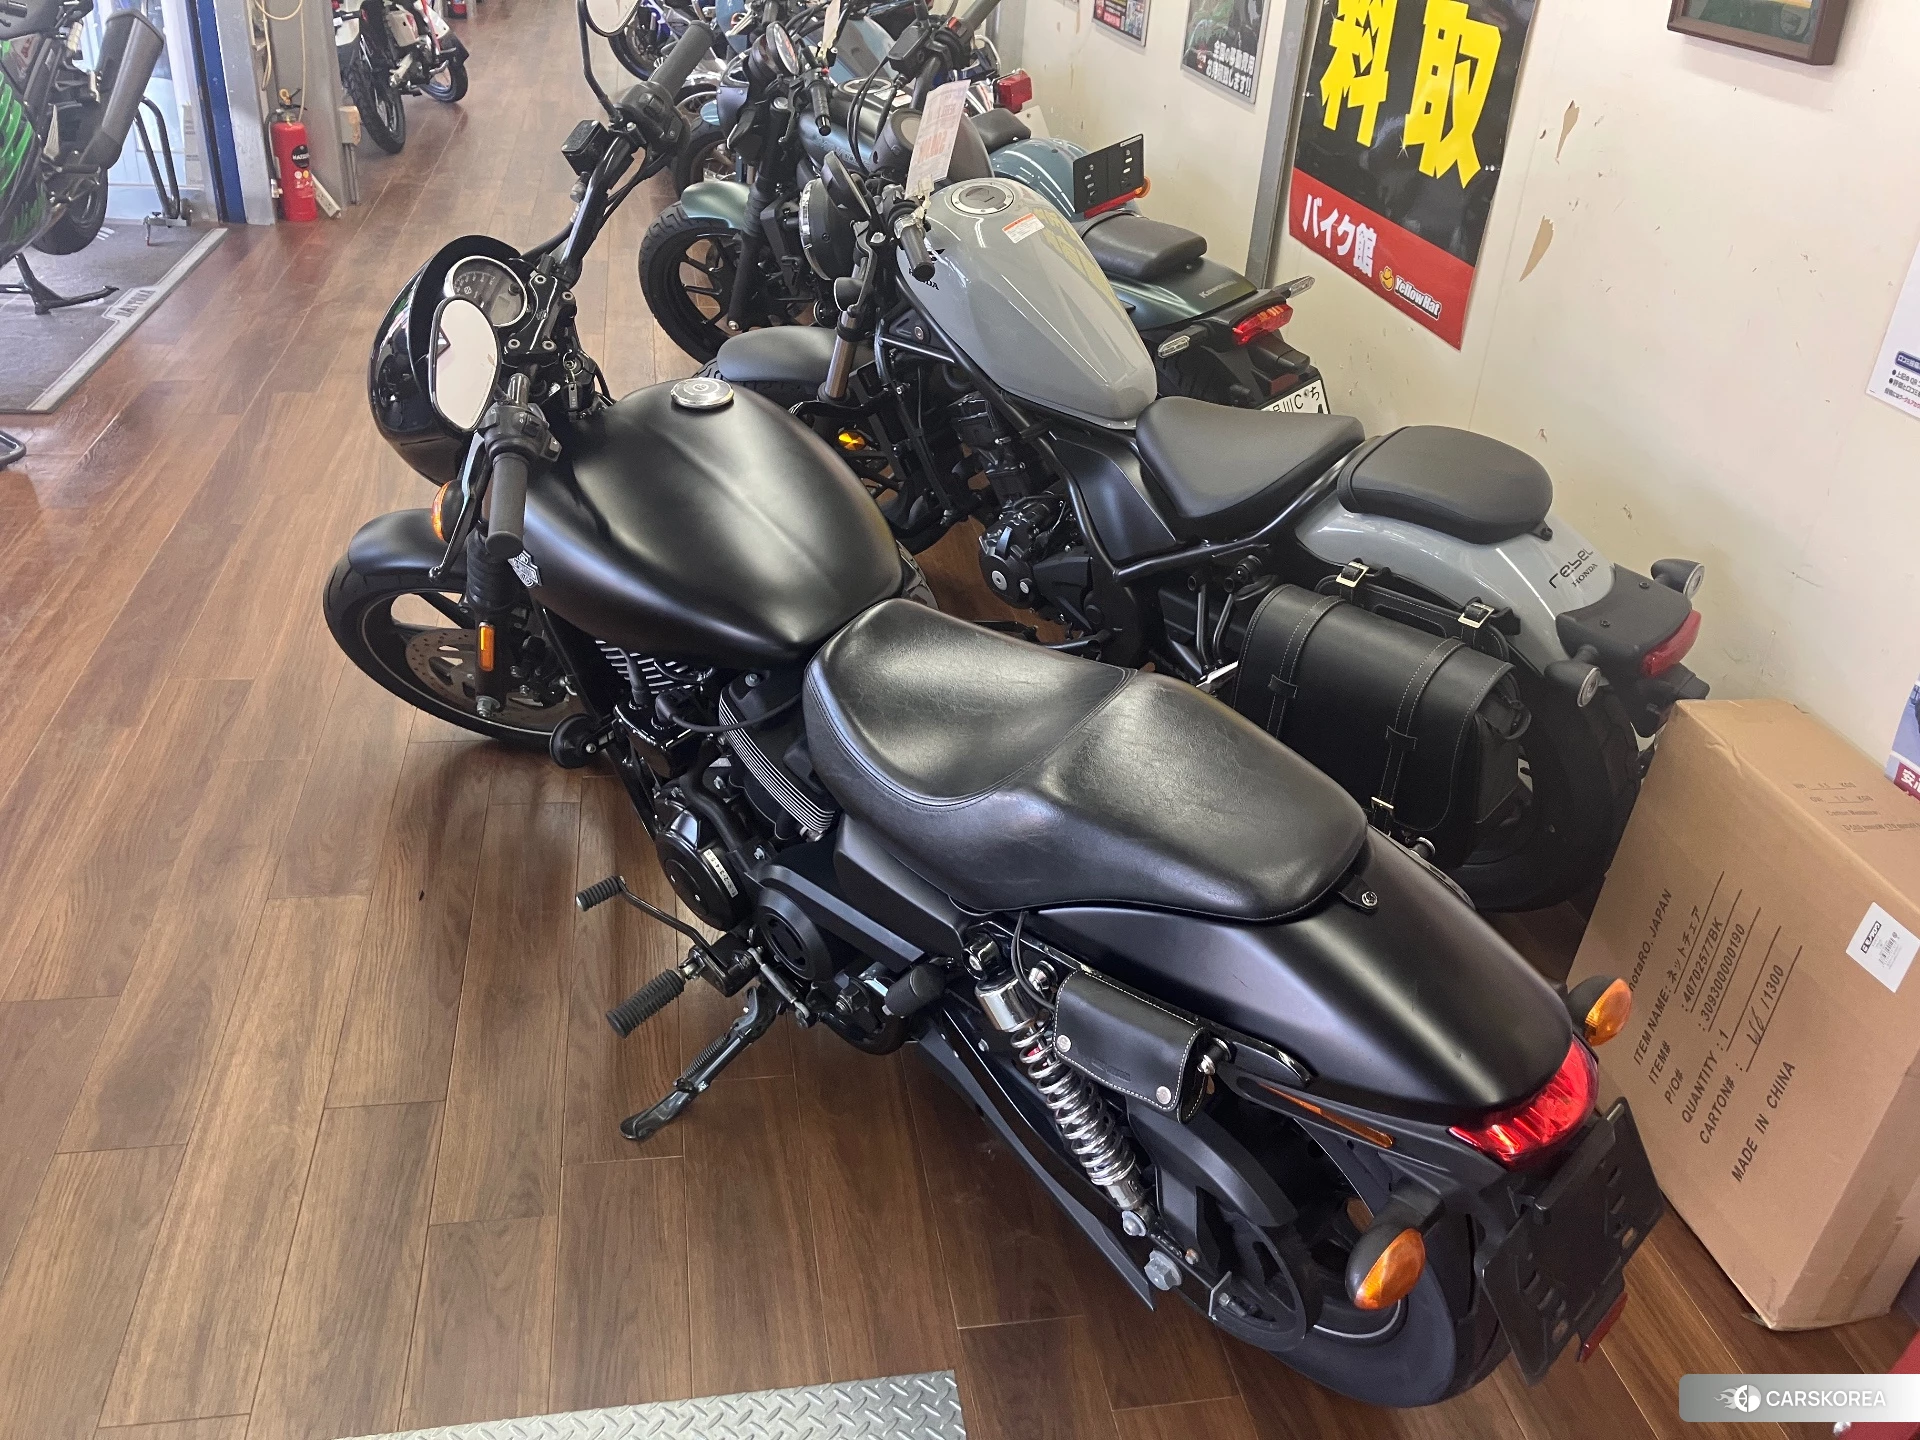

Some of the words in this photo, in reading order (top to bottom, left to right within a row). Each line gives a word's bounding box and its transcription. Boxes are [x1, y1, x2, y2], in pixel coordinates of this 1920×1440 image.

[1404, 0, 1501, 189] 取
[1302, 194, 1377, 278] バイク館
[1571, 563, 1598, 587] HONDA
[1649, 888, 1672, 938] JAPAN
[1634, 1029, 1652, 1065] ITEM
[1648, 986, 1671, 1032] NAME:
[1667, 905, 1700, 983] ネットチェア
[1648, 1040, 1671, 1085] ITEM#
[1664, 1068, 1684, 1104] P/O#
[1682, 1050, 1718, 1123] QUANTITY
[1700, 1075, 1736, 1144] CARTON#
[1731, 1137, 1758, 1182] MADE
[1754, 1113, 1770, 1135] IN
[1766, 1061, 1795, 1109] CHINA
